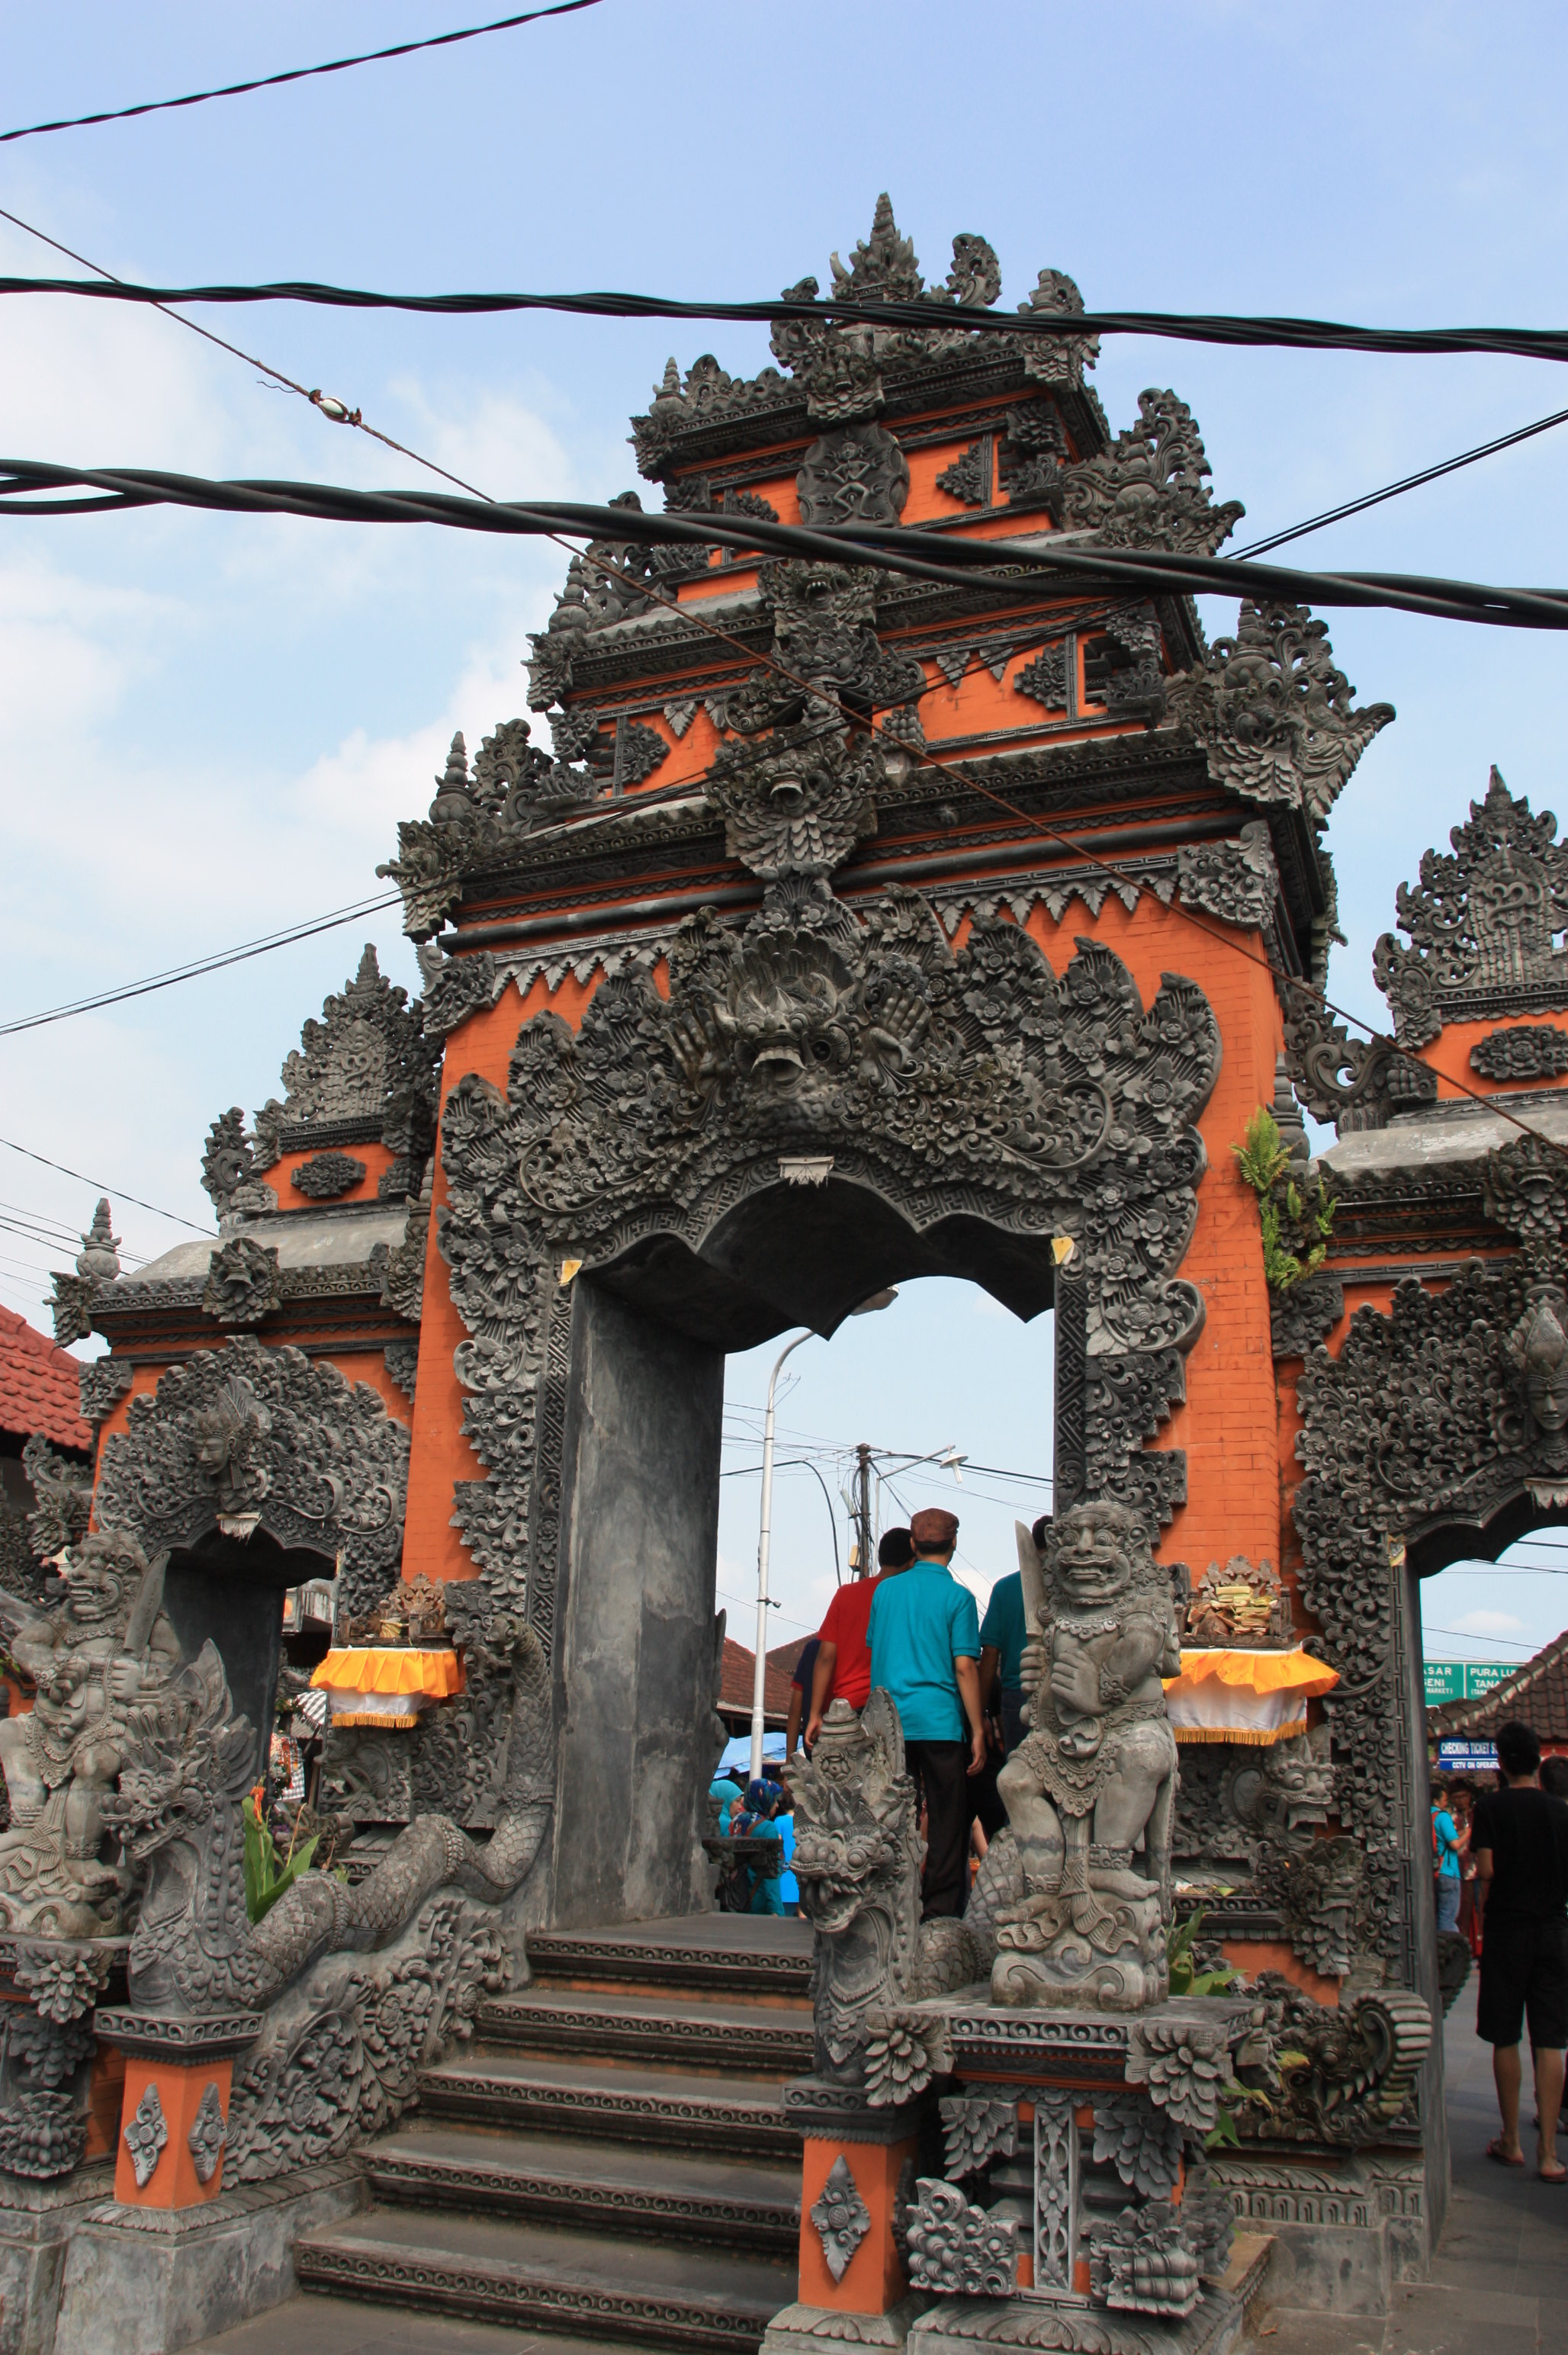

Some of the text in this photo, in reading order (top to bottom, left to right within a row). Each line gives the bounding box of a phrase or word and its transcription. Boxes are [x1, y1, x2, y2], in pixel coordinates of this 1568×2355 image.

[1470, 1668, 1516, 1677] PURA LU
[1441, 1742, 1469, 1755] CHECKING
[1470, 1742, 1489, 1755] TICKET
[1452, 1761, 1466, 1769] CCTV
[1467, 1761, 1475, 1769] ON
